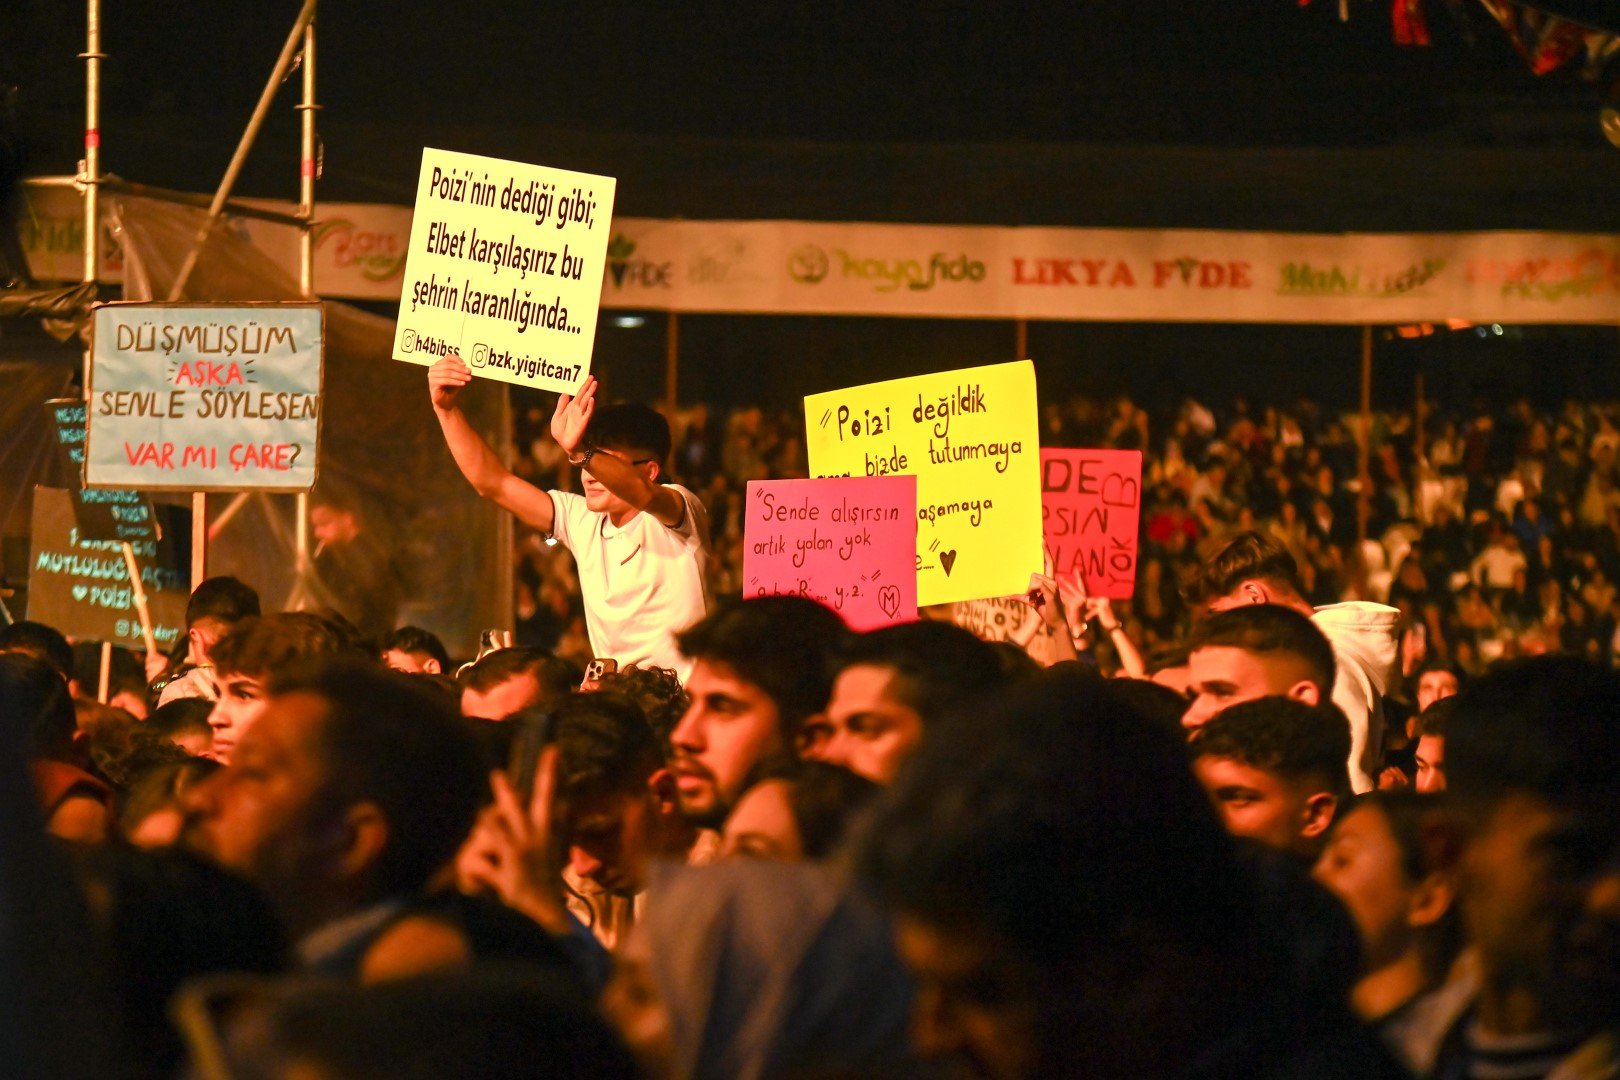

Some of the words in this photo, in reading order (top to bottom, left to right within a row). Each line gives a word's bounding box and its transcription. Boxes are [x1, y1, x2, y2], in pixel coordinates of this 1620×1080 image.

[430, 166, 497, 208] Poizi'nin
[500, 177, 556, 226] dediği
[556, 188, 597, 230] gibi;
[426, 221, 466, 260] Elbet
[468, 227, 557, 280] karşılaşırız
[560, 243, 584, 281] bu
[412, 273, 459, 313] şehrin
[461, 279, 582, 334] karanlığında...
[117, 321, 298, 357] DÜŞMÜŞÜM
[414, 334, 461, 357] h4bibss
[175, 359, 245, 388] AŞKA
[487, 347, 582, 384] bzk.yigitcan7
[99, 390, 187, 420] SENLE
[197, 387, 319, 421] SÖYLESEN
[912, 384, 988, 439] değildik
[124, 442, 175, 470] VAR
[181, 445, 217, 471] MI
[228, 442, 303, 472] ÇARE?
[864, 444, 908, 478] bizde
[928, 438, 1023, 473] tutunmaya
[1042, 458, 1103, 495] DE
[831, 496, 900, 525] alışırsın
[917, 499, 993, 528] aşamaya
[1041, 506, 1109, 537] RSIN
[753, 534, 786, 556] artık
[792, 528, 834, 568] yalan
[838, 528, 872, 562] yok
[1054, 545, 1106, 578] LAN
[1107, 537, 1135, 587] YOK
